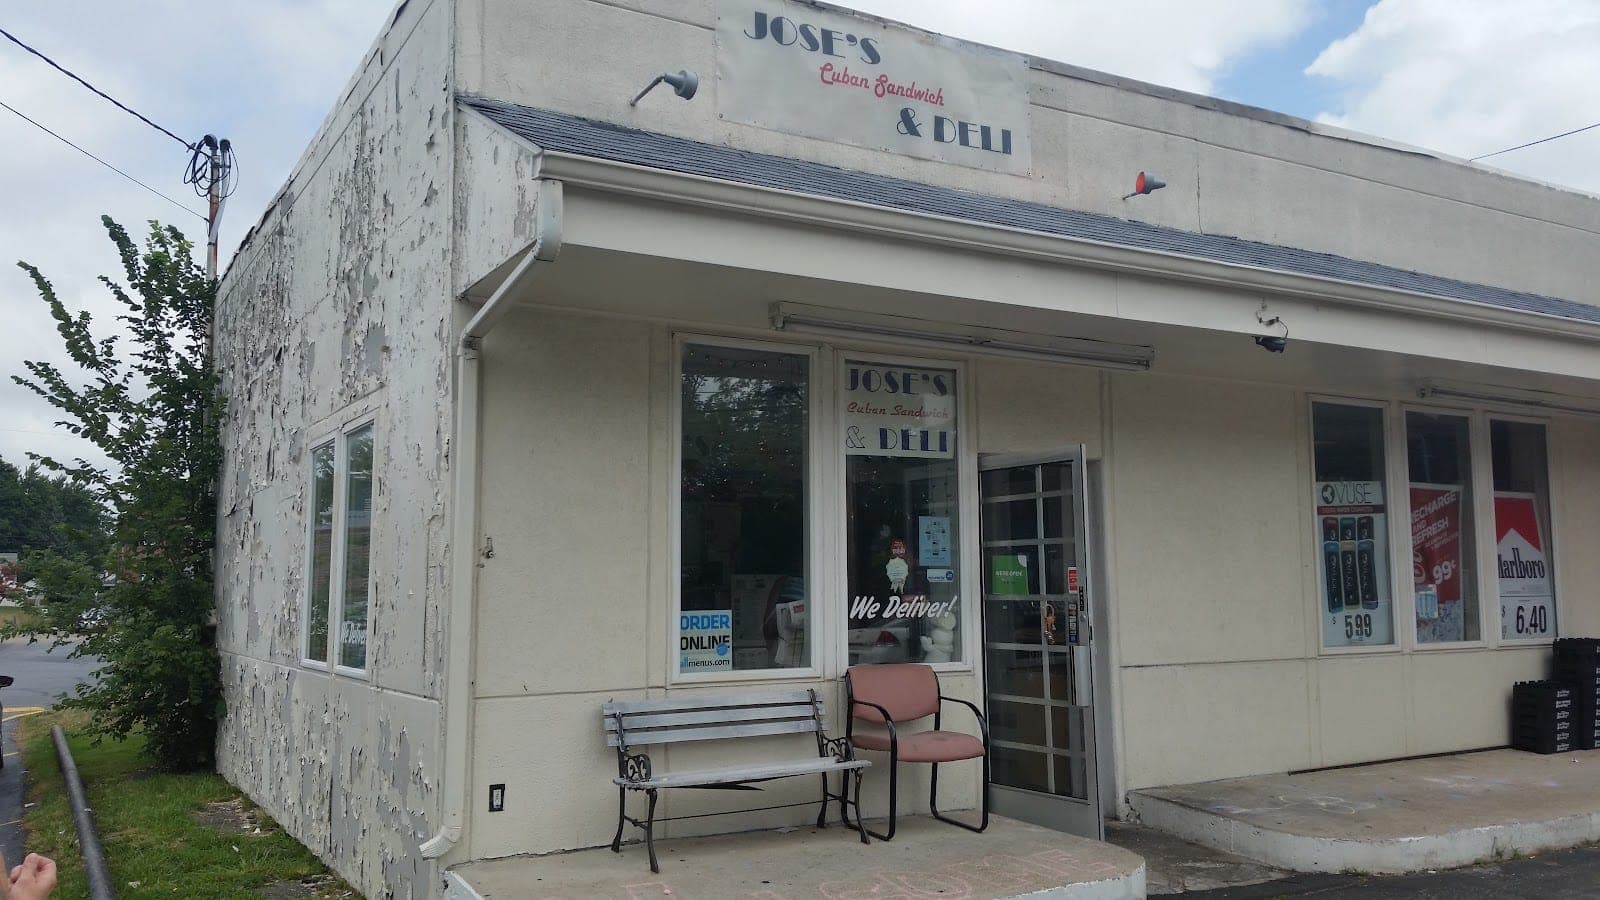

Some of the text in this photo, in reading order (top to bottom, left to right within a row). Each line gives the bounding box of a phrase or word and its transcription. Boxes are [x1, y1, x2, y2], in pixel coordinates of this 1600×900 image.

[743, 11, 881, 65] JOSE'S
[819, 62, 945, 106] Cuban Sandwich
[896, 107, 1012, 155] & DELI
[845, 368, 948, 396] JOSE'S
[847, 402, 949, 418] Cuban Sandwich
[845, 425, 948, 452] & DELI
[1335, 482, 1373, 504] VUSE
[849, 595, 958, 619] We Deliver!
[1516, 605, 1547, 634] 6.40
[680, 614, 730, 631] ORDER
[680, 635, 730, 651] ONLINE
[680, 657, 730, 669] allmenus.com
